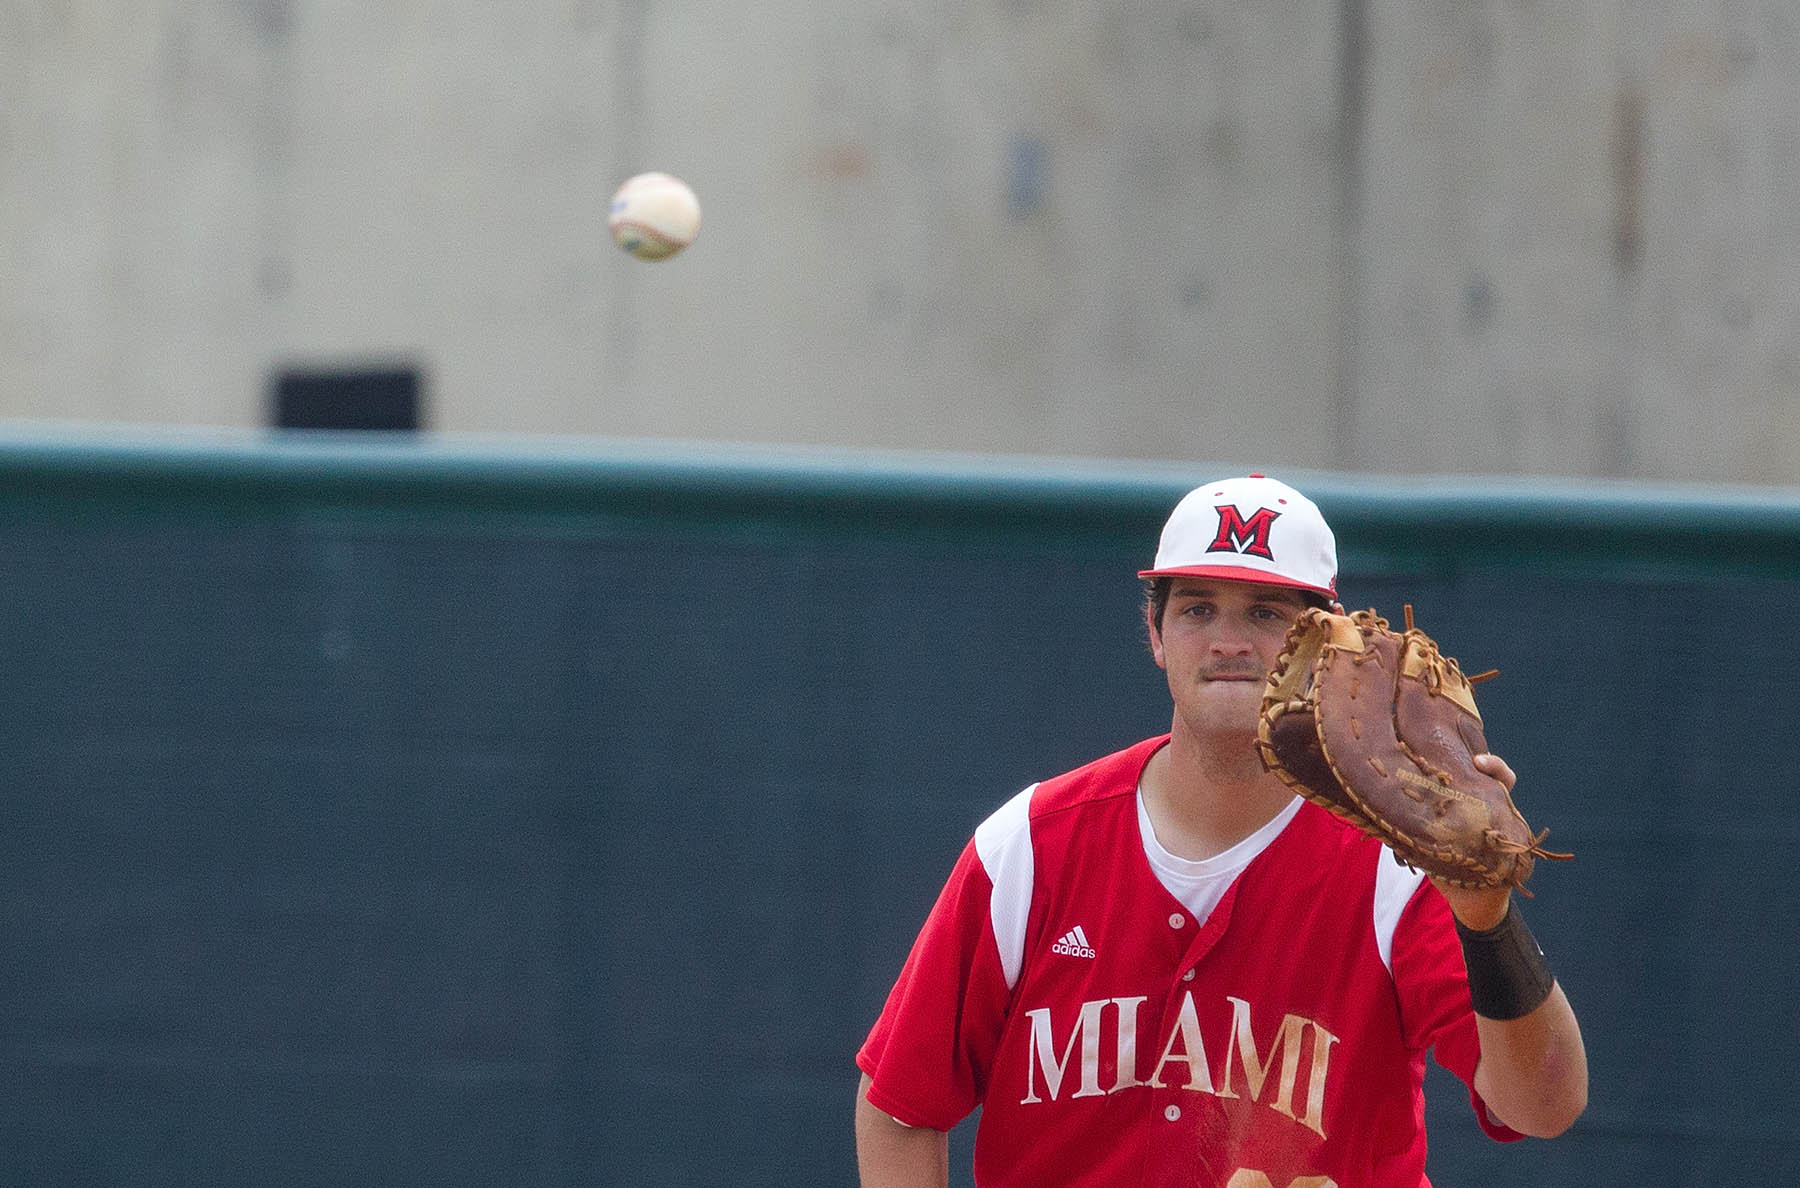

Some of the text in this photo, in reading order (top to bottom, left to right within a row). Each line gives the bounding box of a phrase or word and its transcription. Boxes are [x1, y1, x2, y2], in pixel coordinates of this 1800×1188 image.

[1204, 504, 1282, 562] M
[1052, 943, 1096, 959] adidas
[1020, 990, 1340, 1140] MIAMI
